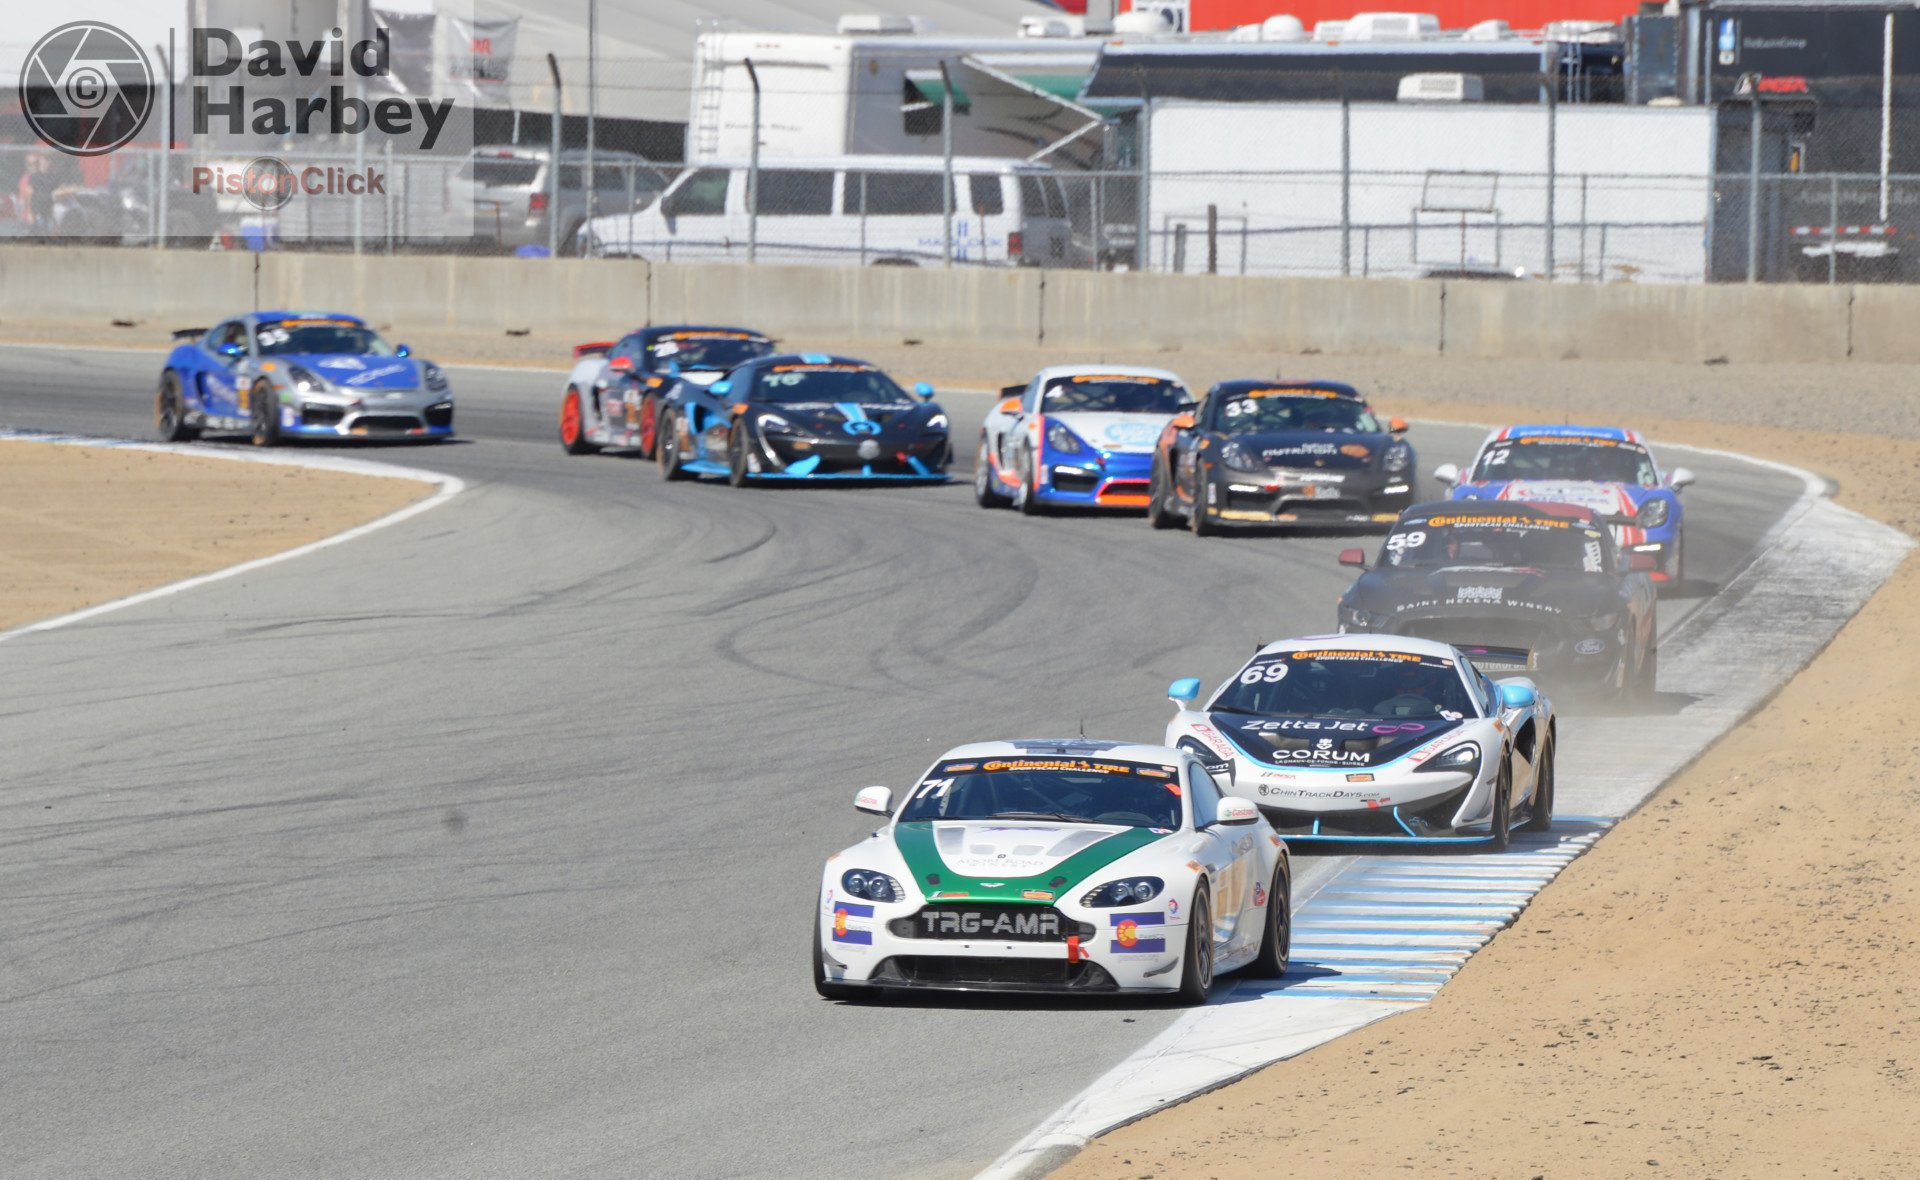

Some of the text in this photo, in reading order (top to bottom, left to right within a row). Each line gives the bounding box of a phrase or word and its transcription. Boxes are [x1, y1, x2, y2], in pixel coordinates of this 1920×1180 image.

[1225, 399, 1258, 417] 33
[1483, 449, 1510, 465] 12
[1386, 531, 1426, 550] 59
[1240, 663, 1288, 684] 69
[1241, 720, 1368, 731] Zetta Jet
[1272, 749, 1370, 763] CORUM
[983, 760, 1130, 773] Continental TIRE
[916, 778, 954, 799] 71
[922, 911, 1059, 935] TRG-AMR
